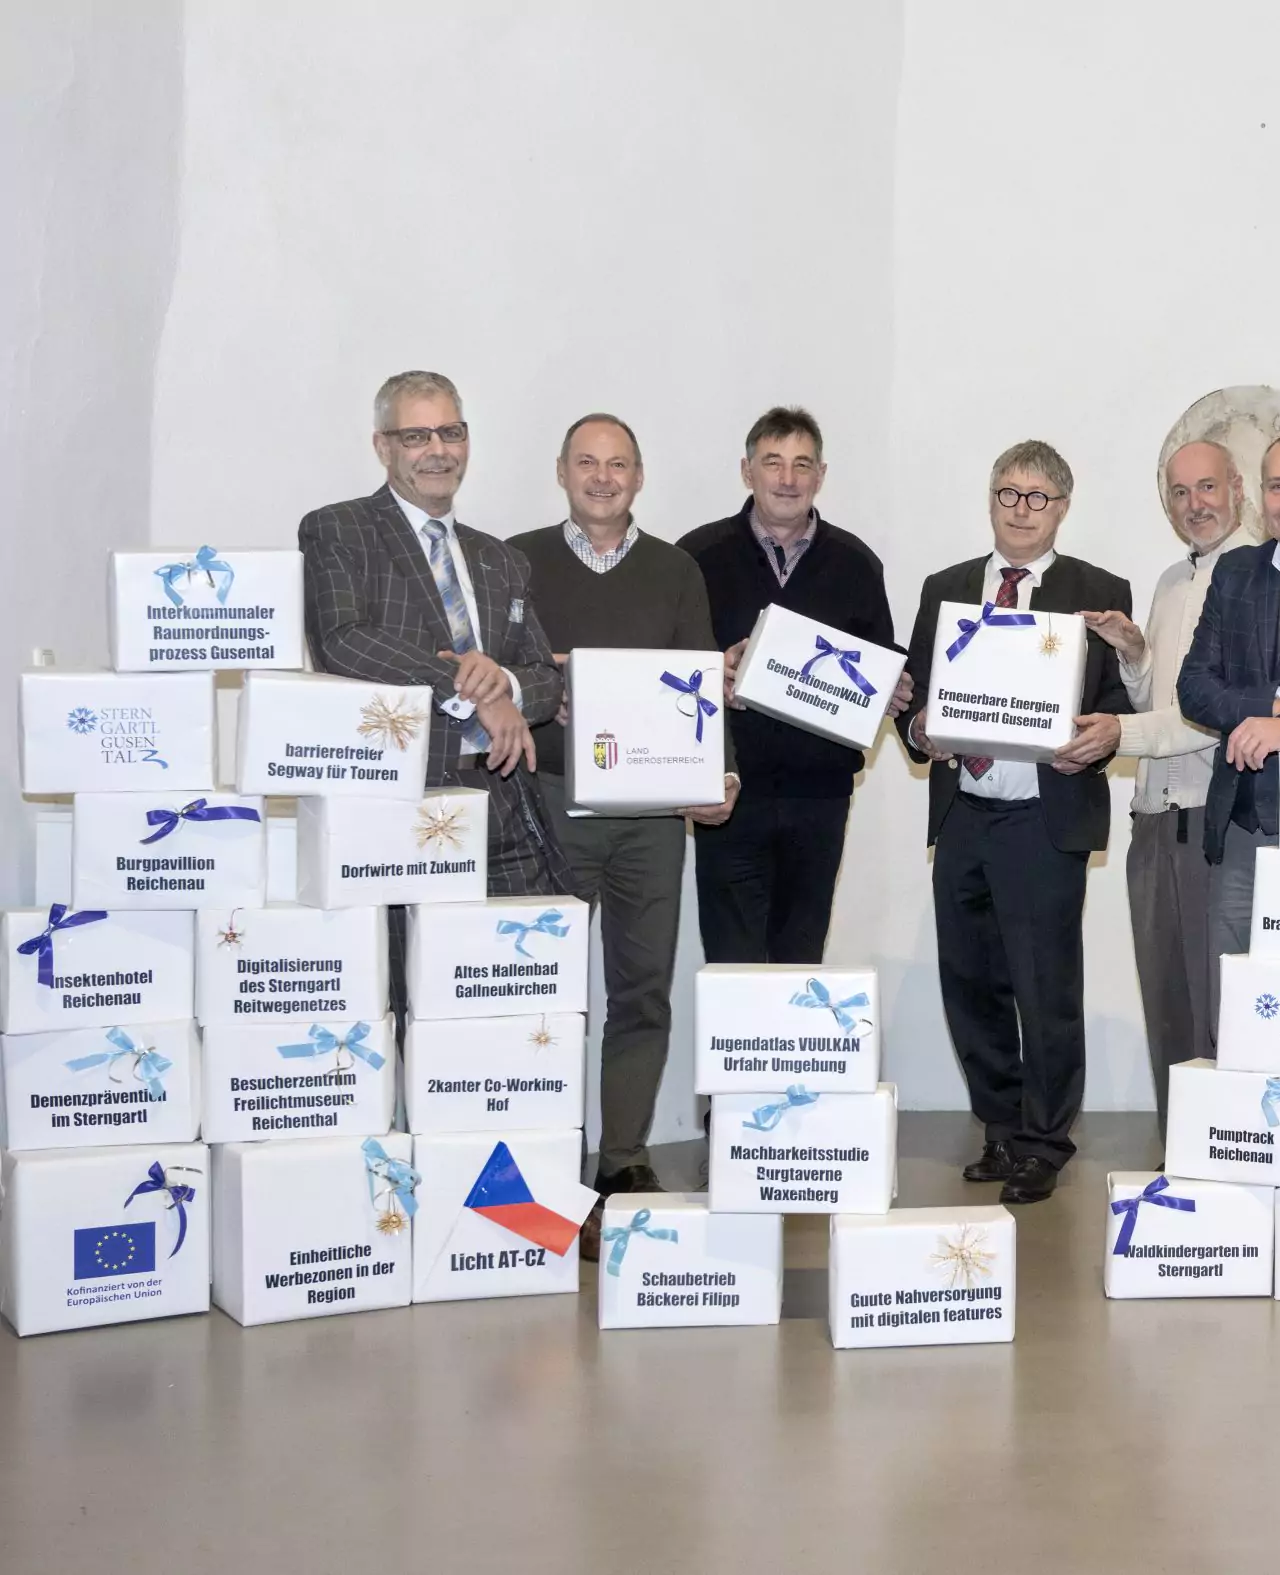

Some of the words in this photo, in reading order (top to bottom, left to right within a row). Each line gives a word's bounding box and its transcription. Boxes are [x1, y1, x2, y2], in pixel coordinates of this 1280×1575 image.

[147, 605, 275, 621] Interkommunaler
[153, 625, 270, 642] Raumordnungs-
[150, 646, 207, 661] prozess
[211, 645, 275, 660] Gusental
[767, 658, 871, 709] GenerationenWALD
[786, 684, 839, 716] Sonnberg
[938, 688, 1006, 709] Erneuerbare
[1010, 695, 1060, 714] Energien
[100, 708, 151, 719] STERN
[941, 706, 999, 726] Sterngartl
[1002, 710, 1052, 729] Gusental
[100, 721, 160, 734] GARTL
[101, 736, 155, 748] GUSEN
[286, 743, 384, 760] barrierefreier
[268, 762, 323, 780] Segway
[327, 764, 347, 780] für
[350, 766, 398, 781] Touren
[117, 857, 214, 875] Burgpavillion
[127, 876, 205, 891] Reichenau
[237, 957, 342, 976] Digitalisierung
[239, 978, 265, 993] des
[269, 977, 340, 995] Sterngartl
[62, 990, 141, 1008] Reichenau
[233, 997, 346, 1016] Reitwegenetzes
[710, 1037, 795, 1052] Jugendatlas
[799, 1037, 860, 1052] VUULKAN
[724, 1057, 768, 1072] Urfahr
[772, 1058, 846, 1074] Umgebung
[428, 1078, 480, 1093] 2kanter
[484, 1077, 567, 1094] Co-Working-
[233, 1092, 355, 1112] Freilichtmuseum
[487, 1096, 509, 1112] Hof
[52, 1113, 71, 1128] im
[74, 1109, 148, 1127] Sterngartl
[252, 1112, 338, 1130] Reichenthal
[1209, 1126, 1274, 1147] Pumptrack
[730, 1145, 869, 1162] Machbarkeitsstudie
[1209, 1146, 1273, 1164] Reichenau
[757, 1166, 842, 1184] Burgtaverne
[760, 1186, 838, 1204] Waxenberg
[290, 1243, 371, 1265] Einheitliche
[450, 1250, 494, 1272] Licht
[498, 1248, 546, 1269] AT-CZ
[265, 1266, 353, 1289] Werbezonen
[356, 1265, 368, 1279] in
[371, 1261, 394, 1277] der
[642, 1272, 736, 1286] Schaubetrieb
[1158, 1263, 1224, 1279] Sterngartl
[67, 1283, 124, 1296] Kofinanziert
[127, 1281, 146, 1290] von
[148, 1277, 162, 1288] der
[308, 1285, 355, 1304] Region
[67, 1292, 131, 1306] Europäischen
[134, 1288, 162, 1301] Union
[637, 1292, 699, 1307] Bäckerei
[702, 1292, 740, 1307] Filipp
[851, 1292, 892, 1308] Guute
[895, 1285, 1002, 1305] Nahversorgung
[851, 1311, 875, 1328] mit
[877, 1308, 940, 1327] digitalen
[943, 1306, 1002, 1322] features
